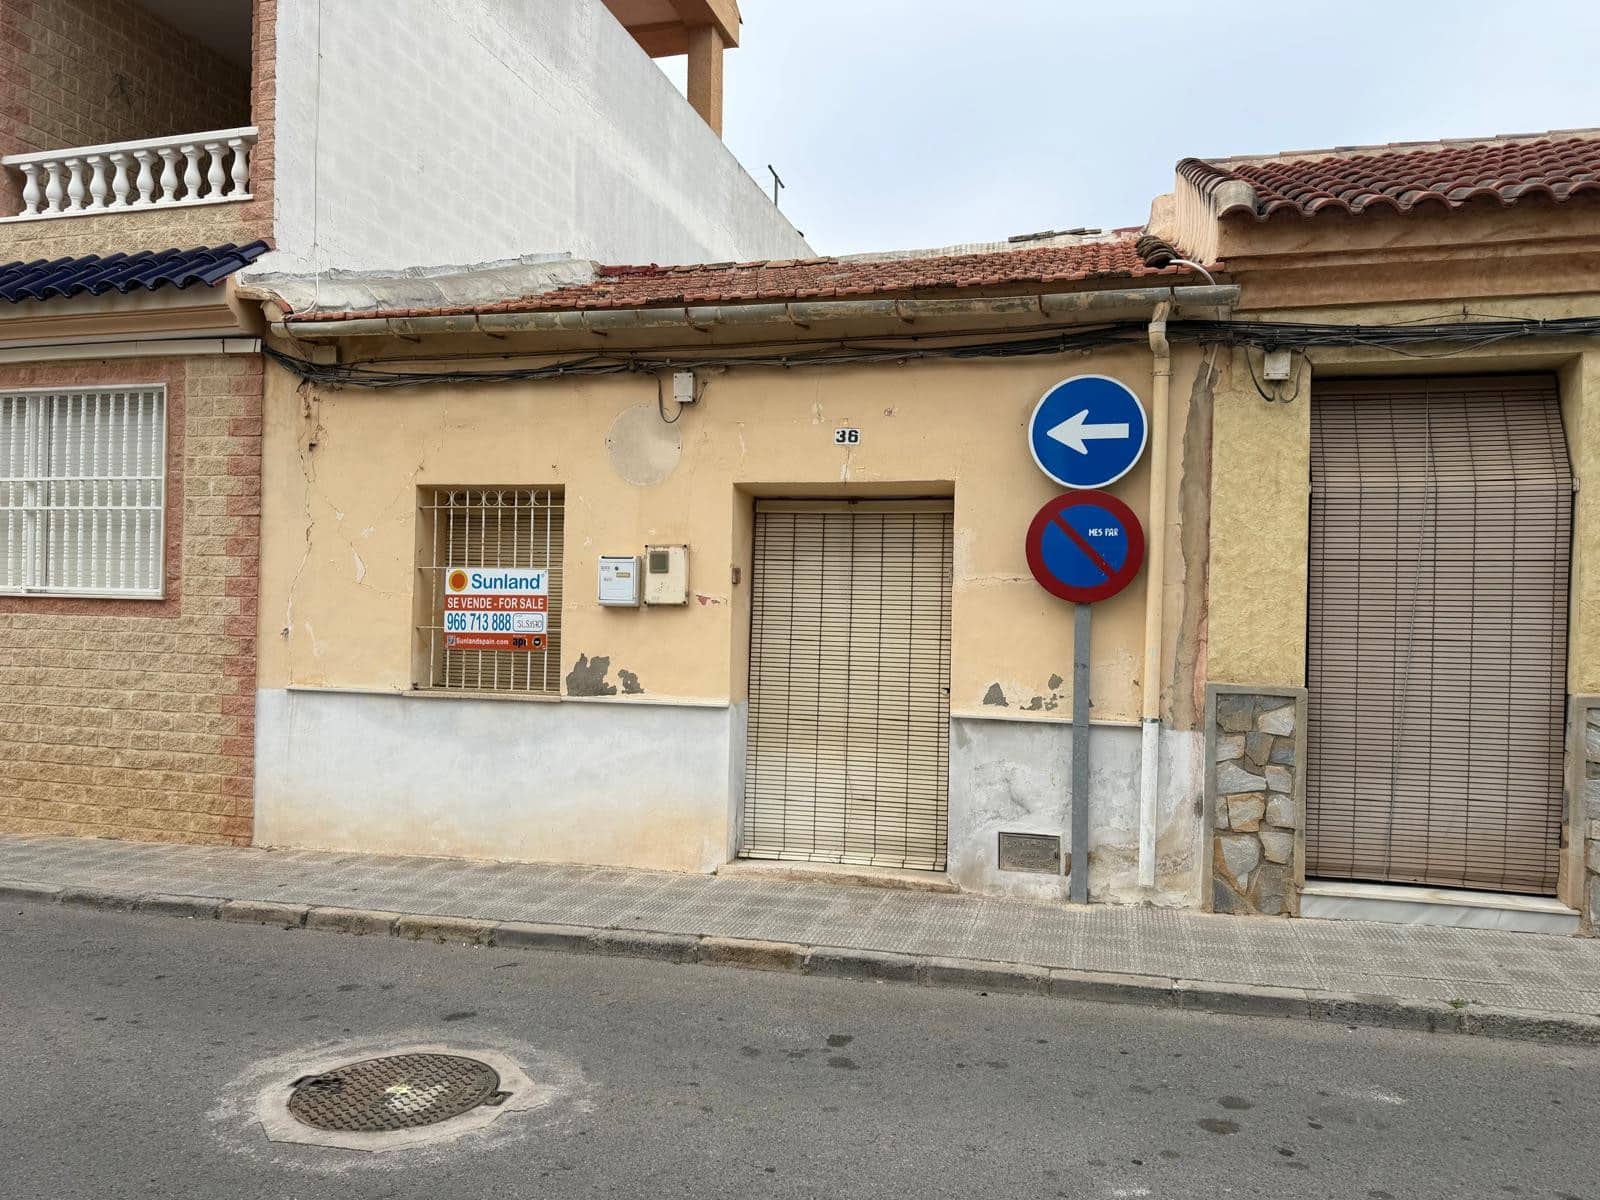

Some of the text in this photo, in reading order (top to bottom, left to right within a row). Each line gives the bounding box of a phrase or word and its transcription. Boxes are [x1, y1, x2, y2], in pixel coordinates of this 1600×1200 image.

[836, 430, 859, 443] 36
[1088, 528, 1103, 536] MES
[471, 573, 541, 590] Sunland
[447, 597, 459, 609] SE
[461, 597, 493, 609] VENDE
[498, 597, 518, 609] FOR
[519, 597, 544, 609] SALE
[447, 612, 512, 631] 966 713 888
